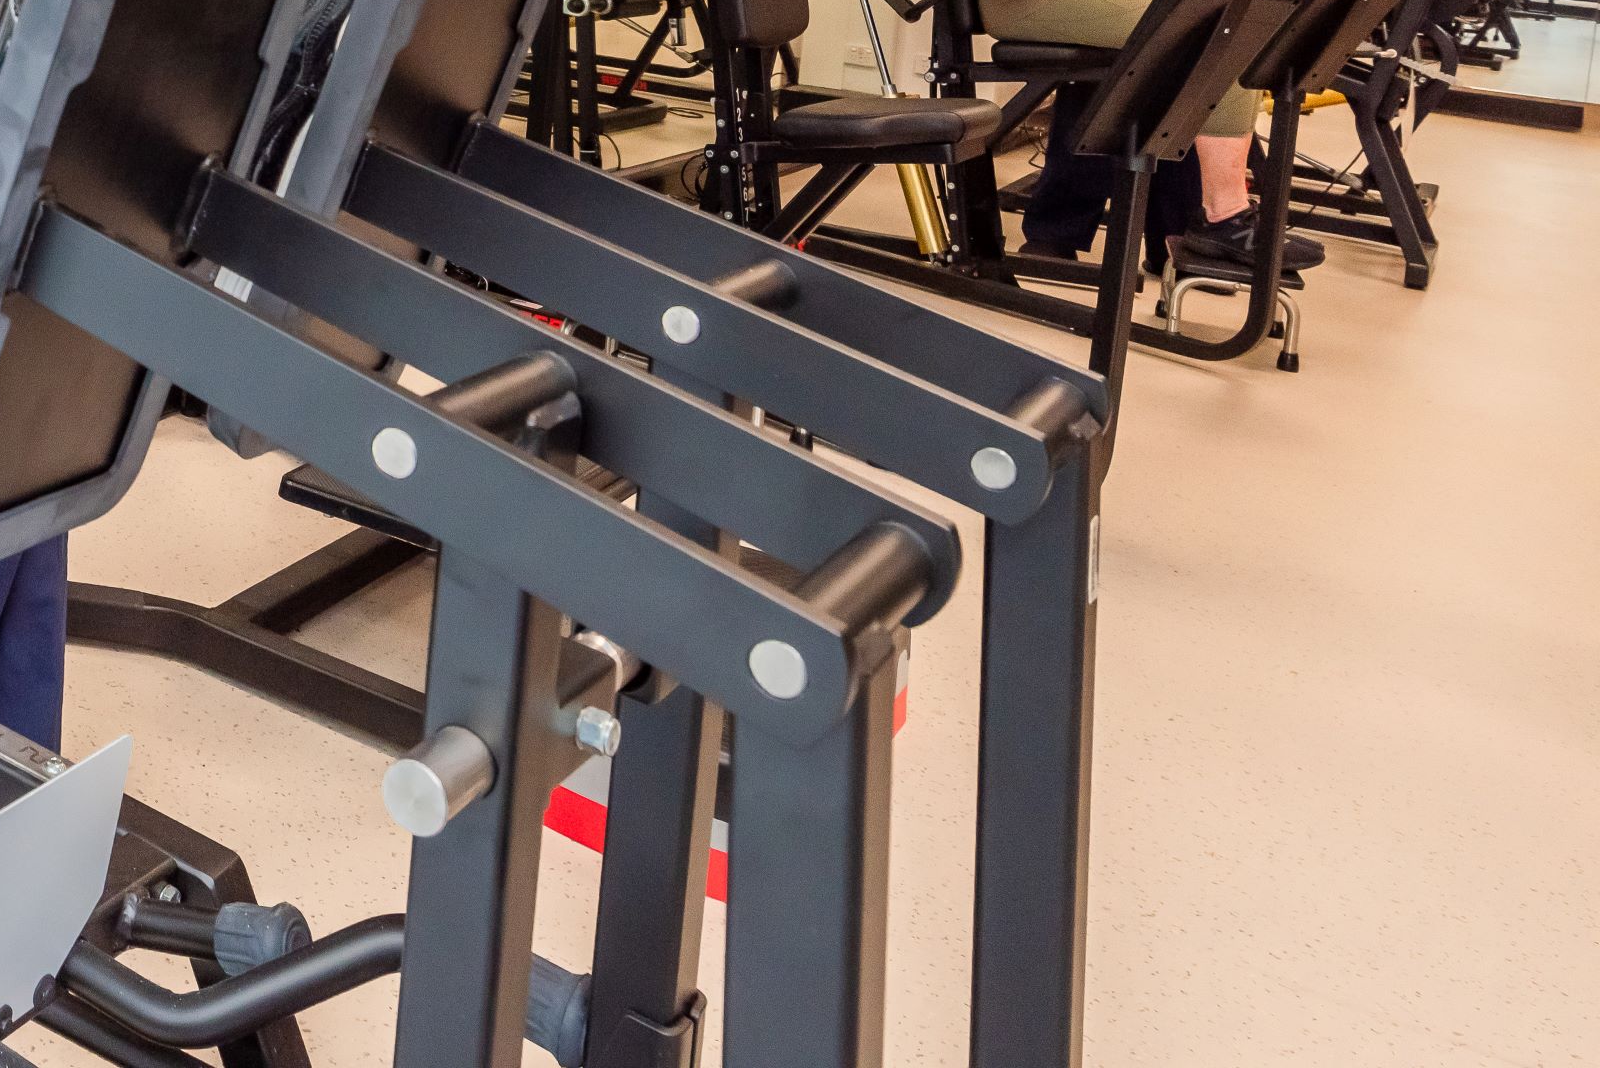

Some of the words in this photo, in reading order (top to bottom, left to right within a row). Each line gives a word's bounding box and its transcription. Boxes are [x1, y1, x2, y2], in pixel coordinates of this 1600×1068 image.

[735, 87, 740, 102] 1
[736, 107, 742, 122] 2
[738, 127, 744, 142] 3
[743, 187, 748, 202] 6
